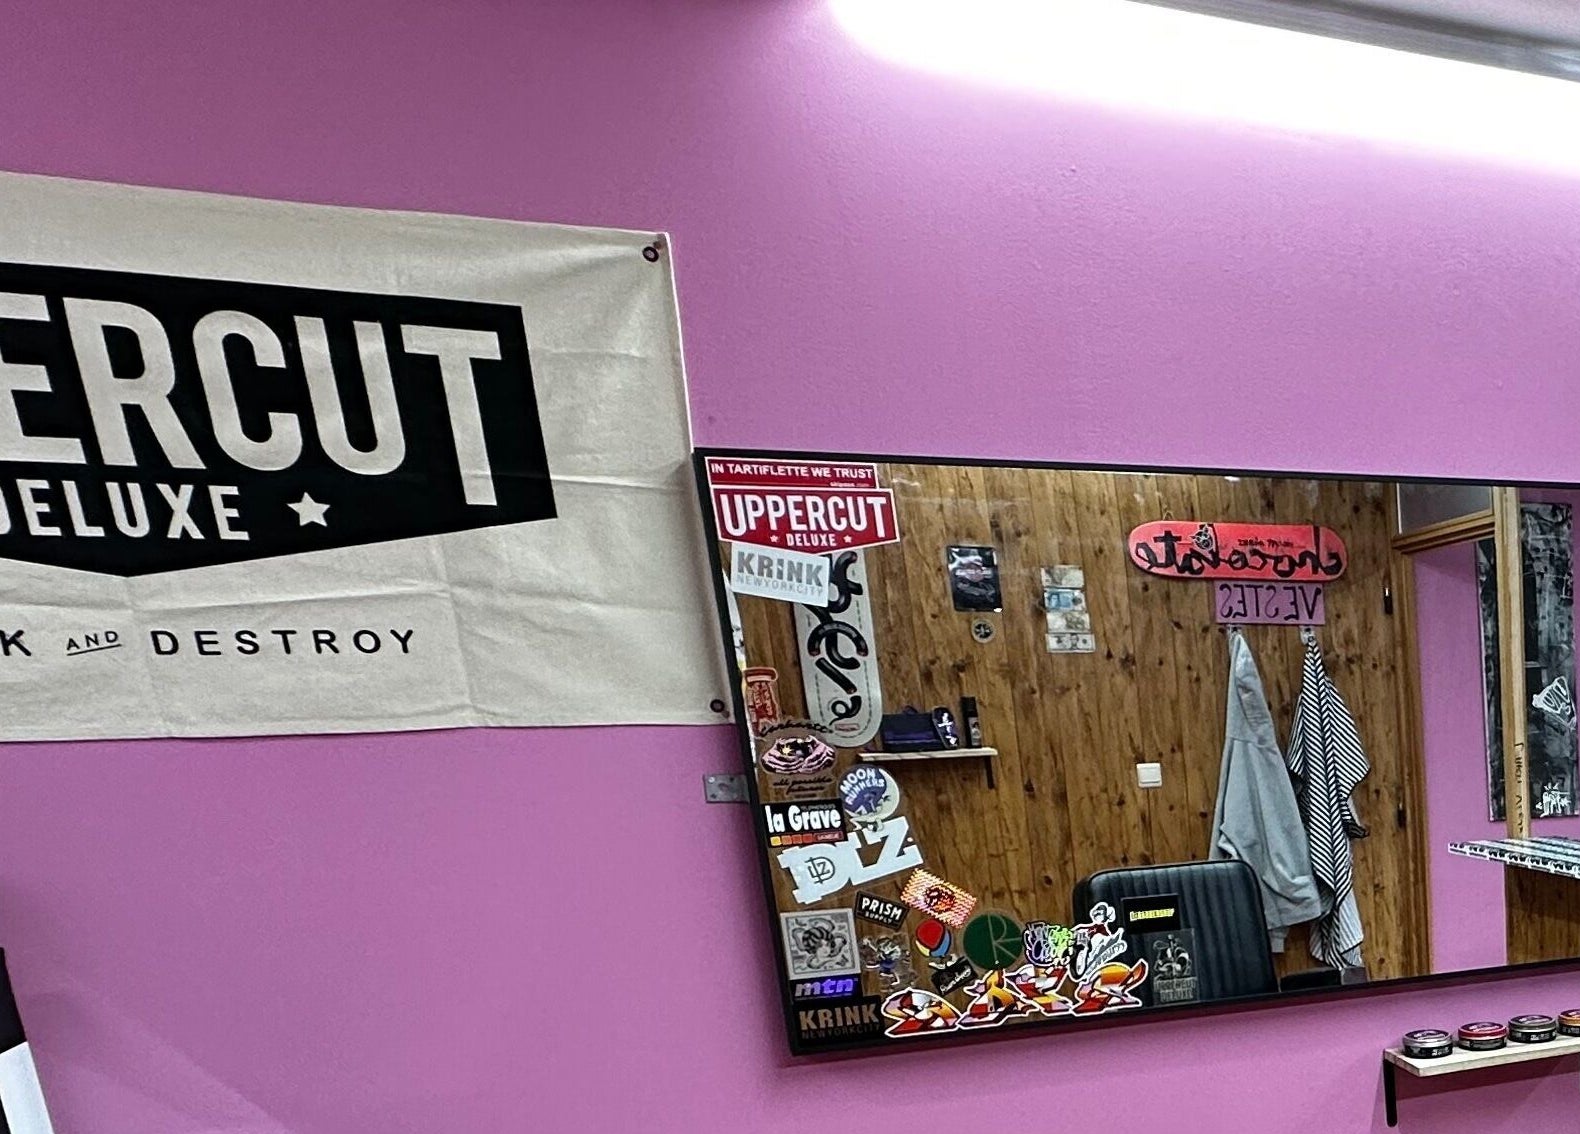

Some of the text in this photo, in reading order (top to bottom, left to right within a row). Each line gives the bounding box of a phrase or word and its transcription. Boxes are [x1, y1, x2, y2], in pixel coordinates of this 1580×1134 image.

[711, 463, 873, 479] IN TARTIFLETTE WE TRUST
[0, 478, 250, 541] ELUXE
[719, 493, 887, 538] UPPERCUT
[786, 533, 837, 547] DELUXE
[737, 551, 823, 587] KRINK
[66, 630, 121, 651] AND
[151, 630, 415, 656] DESTROY
[840, 767, 876, 794] MOON
[765, 804, 841, 833] la Grave
[861, 896, 903, 921] PRISM
[865, 912, 893, 925] SUPPLY
[795, 978, 855, 997] mtn
[800, 1003, 880, 1031] KRINK
